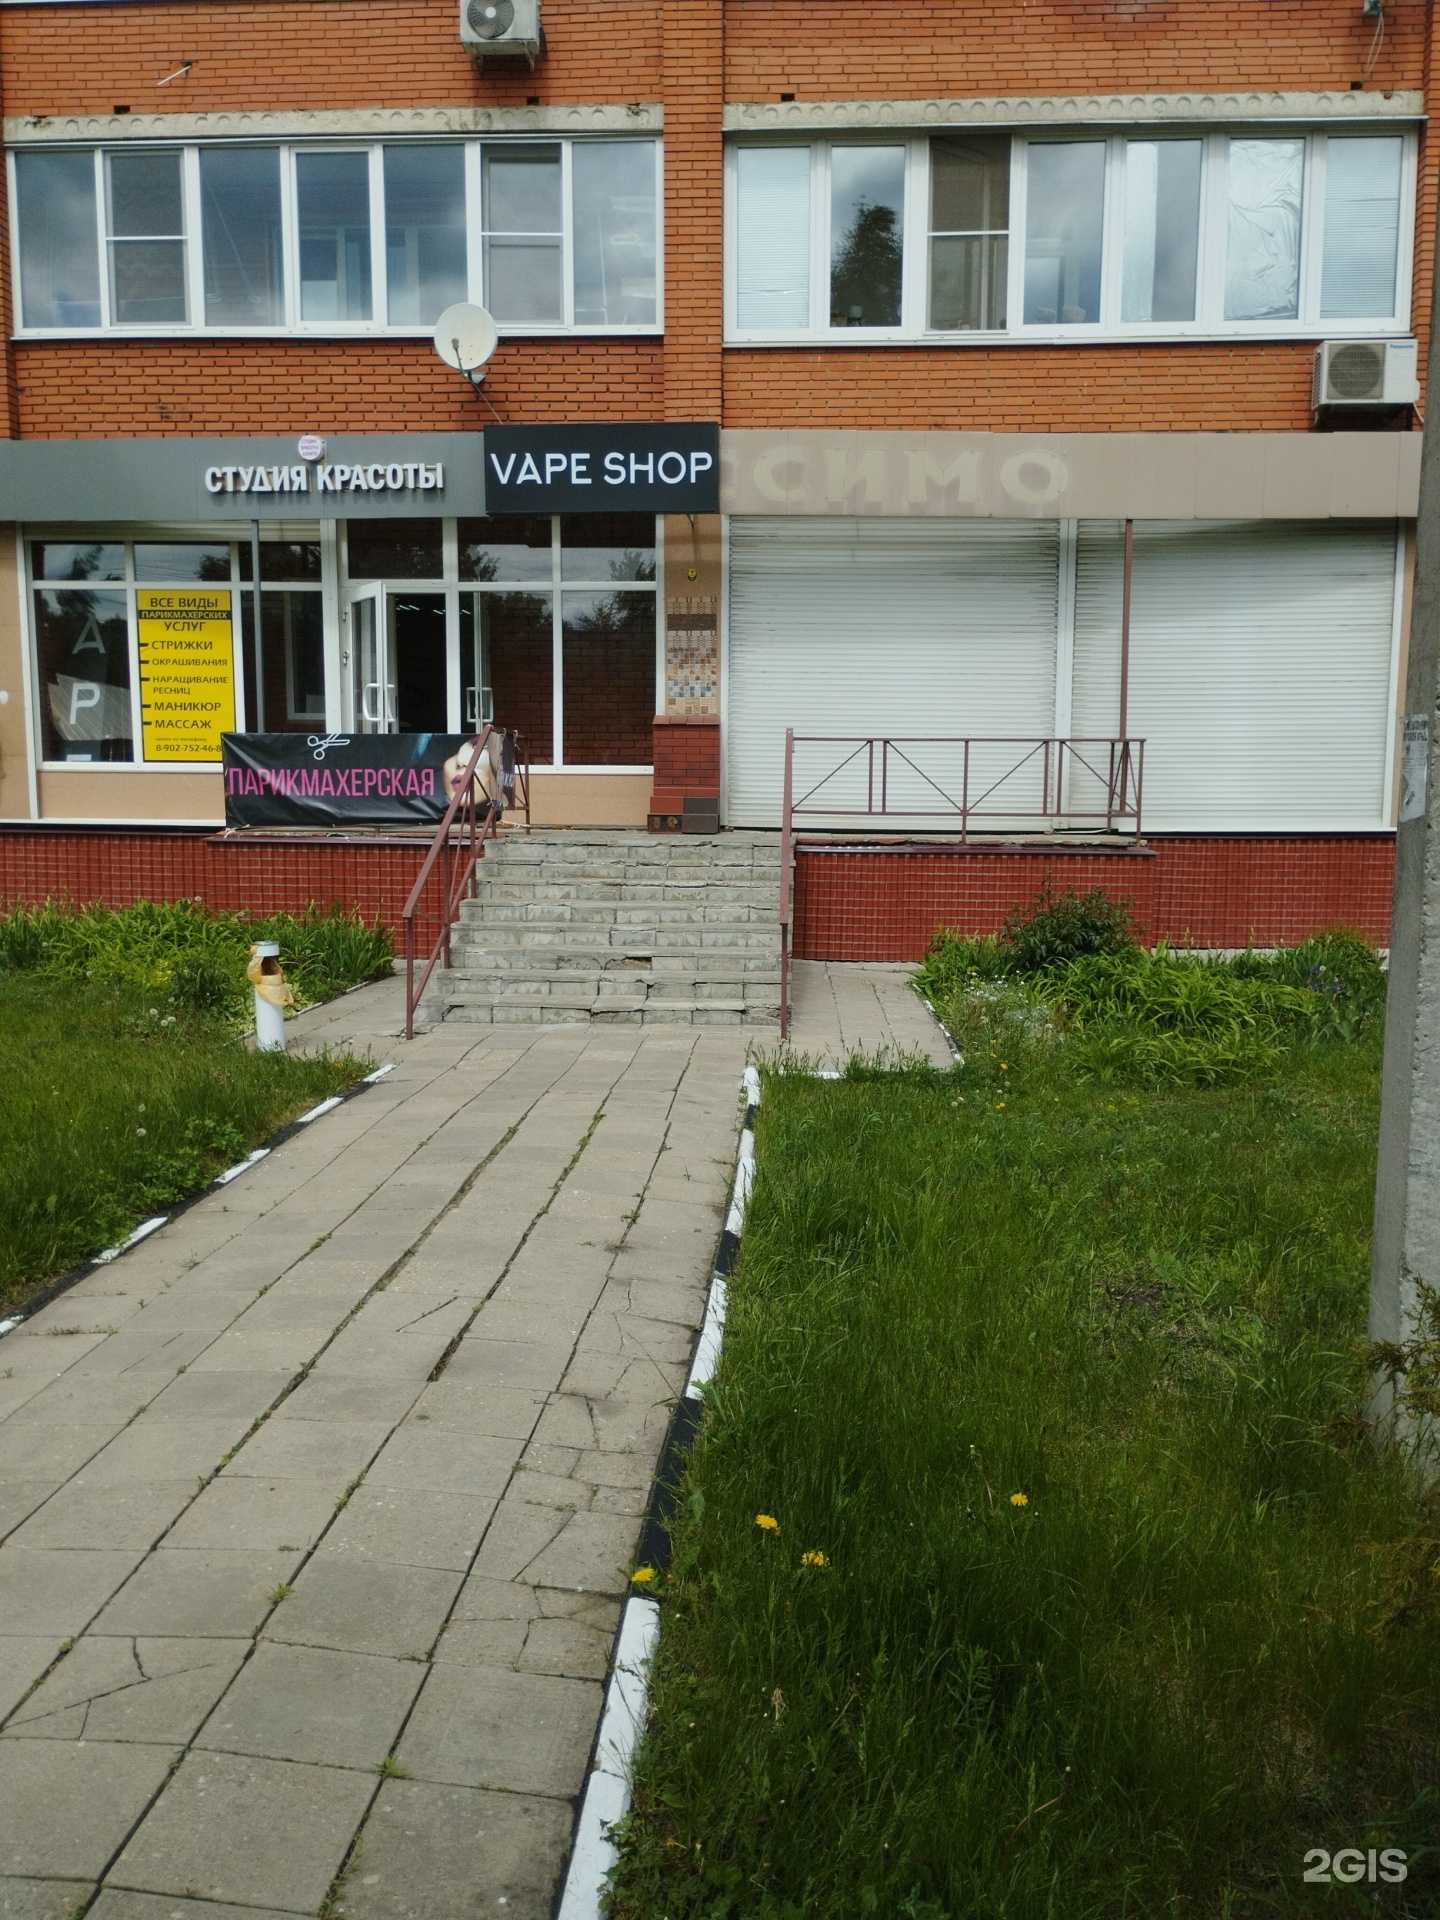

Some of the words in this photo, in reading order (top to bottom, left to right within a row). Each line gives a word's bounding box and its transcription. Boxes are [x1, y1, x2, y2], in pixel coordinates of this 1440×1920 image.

[490, 452, 593, 485] VAPE
[603, 451, 713, 485] SHOP
[204, 465, 308, 493] СТУДИЯ
[317, 462, 444, 491] КРАСОТЫ
[721, 447, 1070, 503] СИМО
[150, 597, 174, 608] ВСЕ
[178, 597, 218, 610] ВИДЫ
[141, 610, 229, 619] ПАРИКМАХЕРСКИХ
[164, 621, 206, 632] УСЛУГ
[151, 640, 213, 651] СТРИЖКИ
[153, 686, 191, 696] РЕСНИЦ
[154, 702, 222, 712] МАНИКЮР
[155, 719, 212, 729] МАССАЖ
[229, 767, 435, 797] ПАРИКМАХЕРСКАЯ
